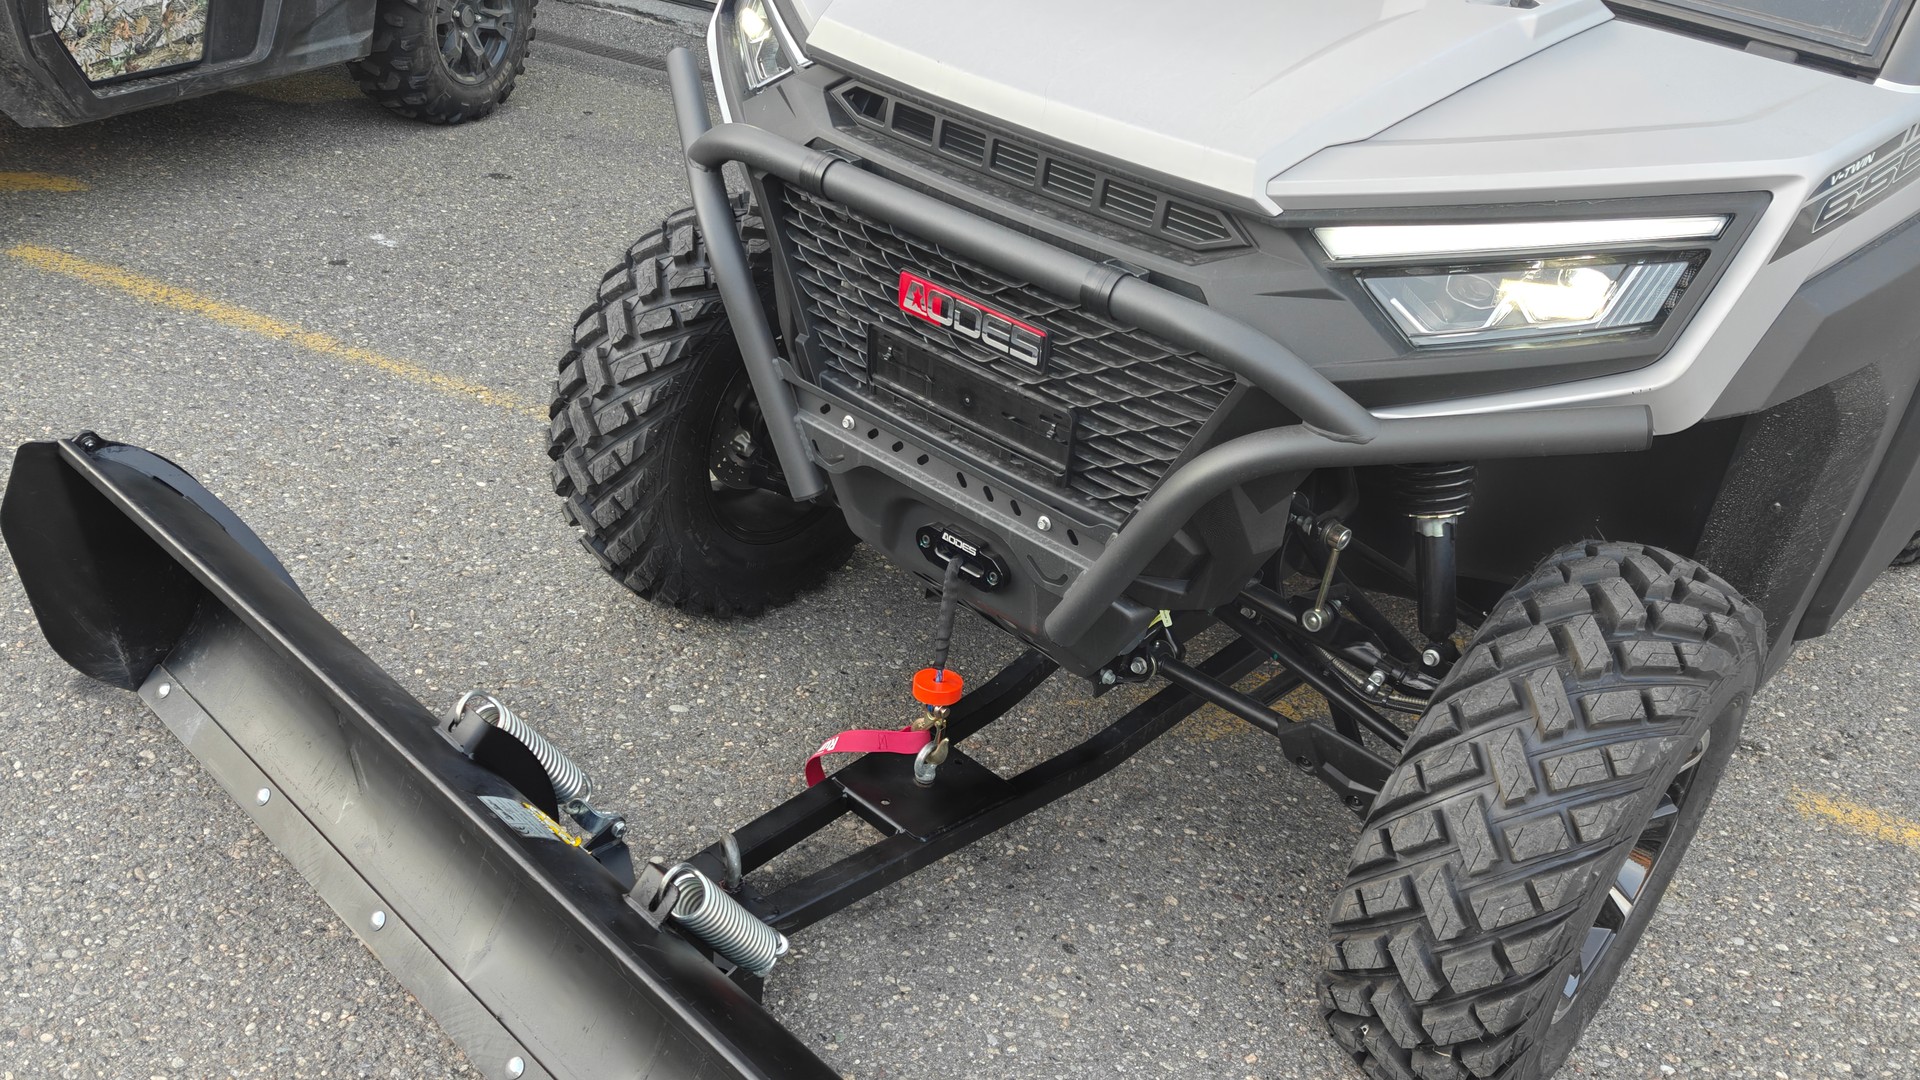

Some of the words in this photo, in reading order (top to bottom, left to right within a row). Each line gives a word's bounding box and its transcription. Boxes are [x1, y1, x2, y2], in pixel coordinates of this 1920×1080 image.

[1831, 151, 1876, 186] V-TWIN
[903, 279, 1040, 367] AODES
[941, 532, 977, 557] AODES
